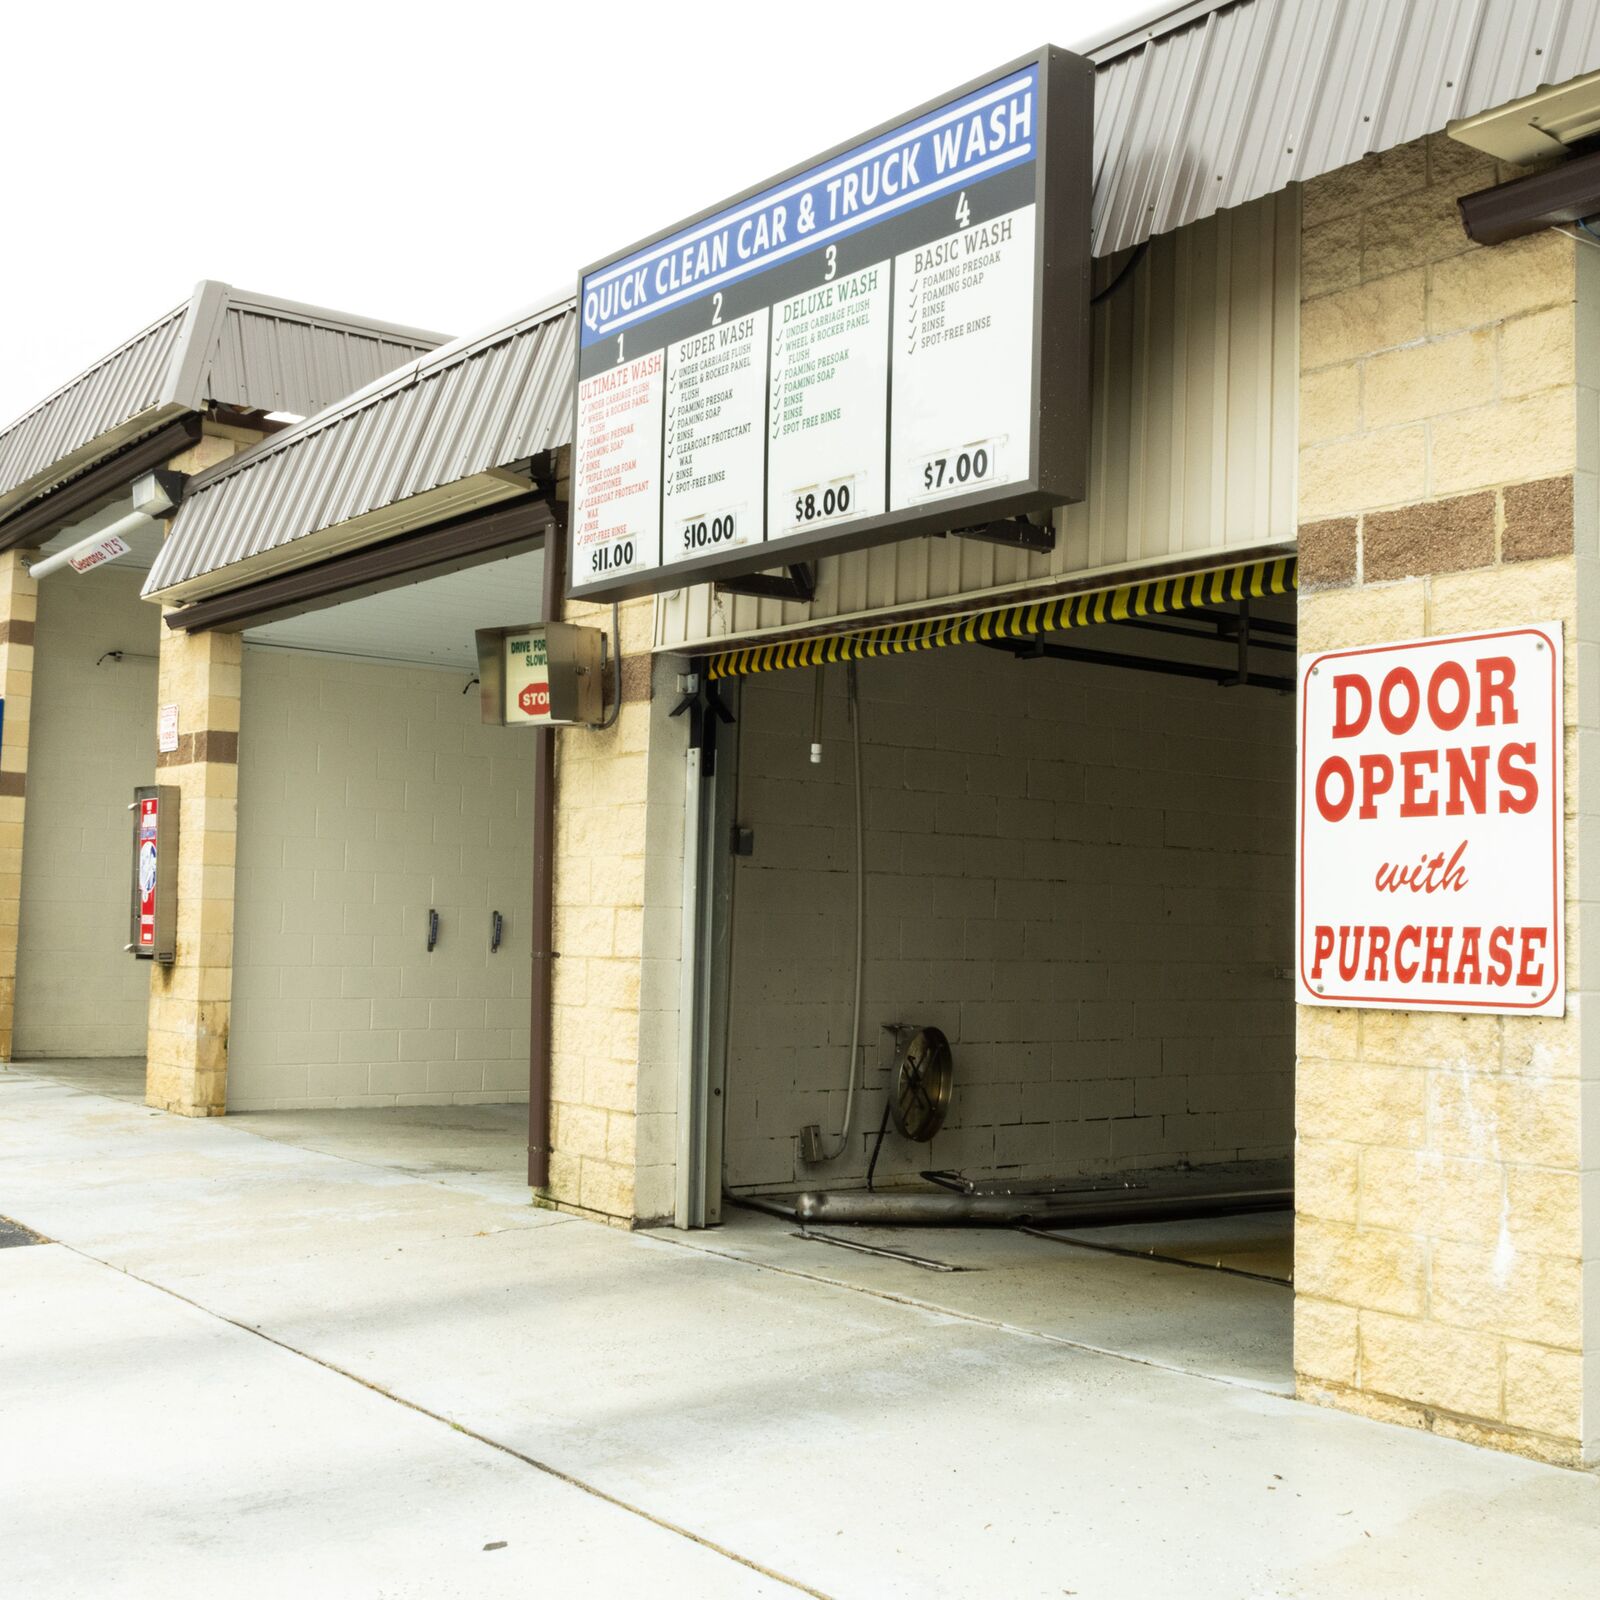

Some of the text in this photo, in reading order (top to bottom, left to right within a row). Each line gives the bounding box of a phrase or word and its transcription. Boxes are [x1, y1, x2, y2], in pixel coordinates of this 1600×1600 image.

[584, 92, 1032, 330] QUICK CLEAN CAR & TRUCK WASH
[955, 192, 970, 228] 4
[914, 218, 1012, 274] BASIC WASH
[824, 244, 836, 280] 3
[922, 250, 1001, 288] FOAMING PRESOAK
[784, 270, 878, 324] DELUXE WASH
[922, 272, 984, 304] FOAMING SOAP
[712, 292, 722, 326] 2
[786, 298, 870, 338] UNDER CARRIAGE FLUSH
[922, 301, 945, 318] RINSE
[680, 318, 754, 362] SUPER WASH
[786, 314, 870, 352] WHEEL & ROCKER PANEL
[921, 315, 991, 348] SPOT-FREE RINSE
[922, 316, 944, 334] RINSE
[617, 333, 624, 363] 1
[679, 343, 751, 378] UNDER CARRIAGE FLUSH
[788, 348, 810, 365] FLUSH
[581, 354, 661, 400] ULTIMATE WASH
[679, 356, 750, 390] WHEEL & ROCKER PANEL
[784, 349, 850, 380] FOAMING PRESOAK
[681, 388, 700, 402] FLUSH
[784, 368, 836, 394] FOAMING SOAP
[678, 388, 734, 416] FOAMING PRESOAK
[783, 406, 803, 422] RINSE
[784, 392, 804, 408] RINSE
[678, 406, 721, 429] FOAMING SOAP
[782, 408, 842, 436] SPOT FREE RINSE
[676, 422, 752, 454] CLEARCOAT PROTECTANT
[677, 428, 694, 442] RINSE
[586, 459, 636, 482] TRIPLE COLOR FOAM
[676, 467, 692, 480] RINSE
[680, 454, 692, 466] WAX
[924, 449, 988, 490] $7.00
[584, 480, 649, 508] CLEARCOAT PROTECTANT
[588, 478, 621, 495] CONDITIONER
[676, 470, 726, 494] SPOT-FREE RINSE
[795, 485, 850, 522] $8.00
[612, 524, 626, 536] RINSE
[684, 514, 734, 550] $10.00
[592, 541, 633, 572] $11.00
[511, 640, 546, 654] DRIVE FOR
[526, 654, 548, 666] SLOWL
[1332, 656, 1520, 739] DOOR
[1315, 742, 1539, 822] OPENS
[1376, 840, 1469, 894] with
[1311, 924, 1548, 987] PURCHASE
